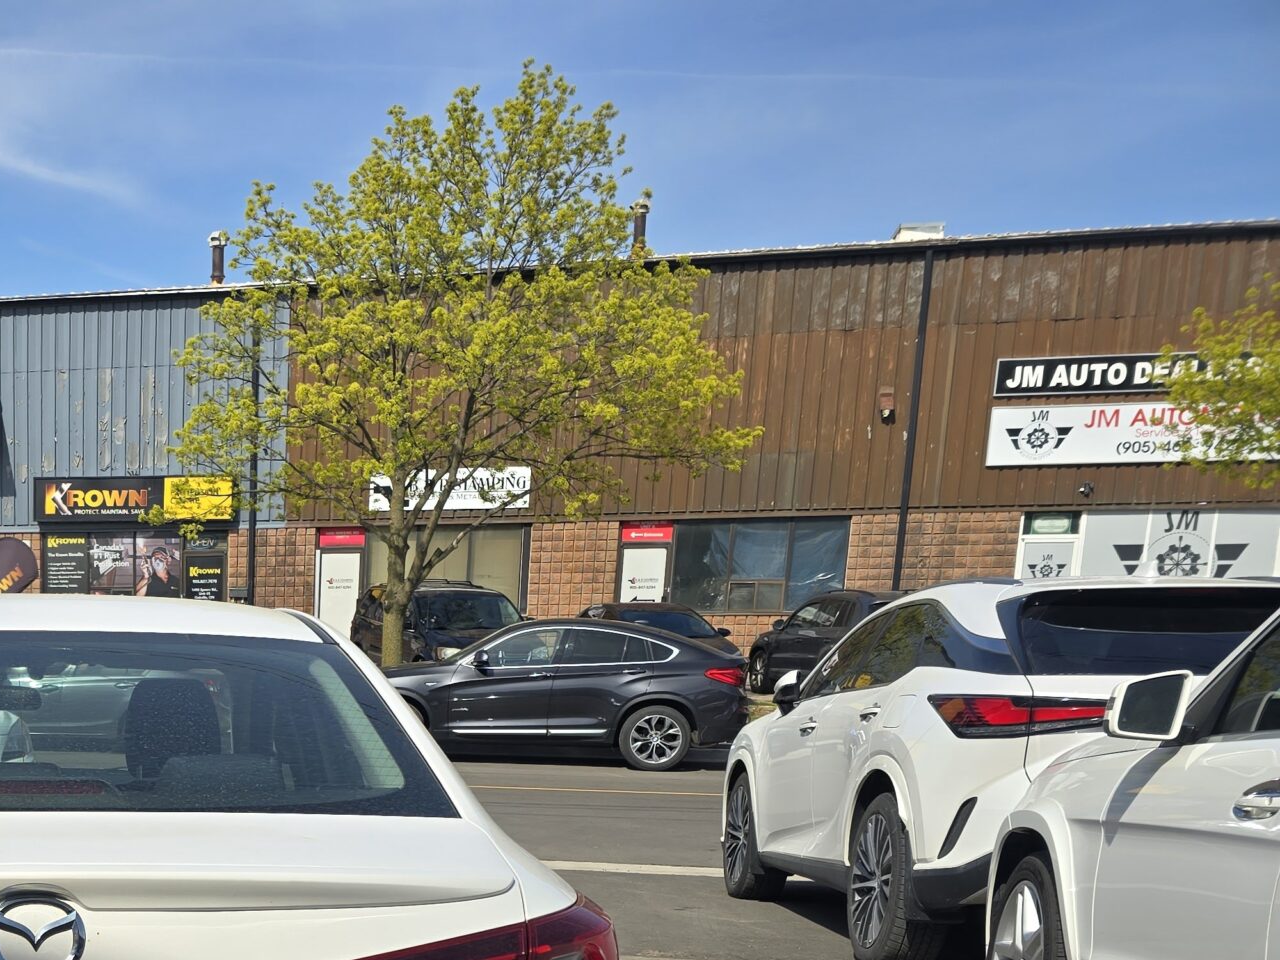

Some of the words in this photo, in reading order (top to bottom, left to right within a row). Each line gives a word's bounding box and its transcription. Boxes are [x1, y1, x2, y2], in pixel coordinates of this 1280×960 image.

[1005, 365, 1044, 389] JM
[1049, 362, 1128, 388] AUTO
[1084, 408, 1121, 429] JM
[1135, 427, 1178, 438] Service
[1116, 440, 1157, 456] (905)
[44, 483, 148, 515] KROWN
[47, 536, 85, 548] KROWN
[189, 567, 221, 577] KROWN
